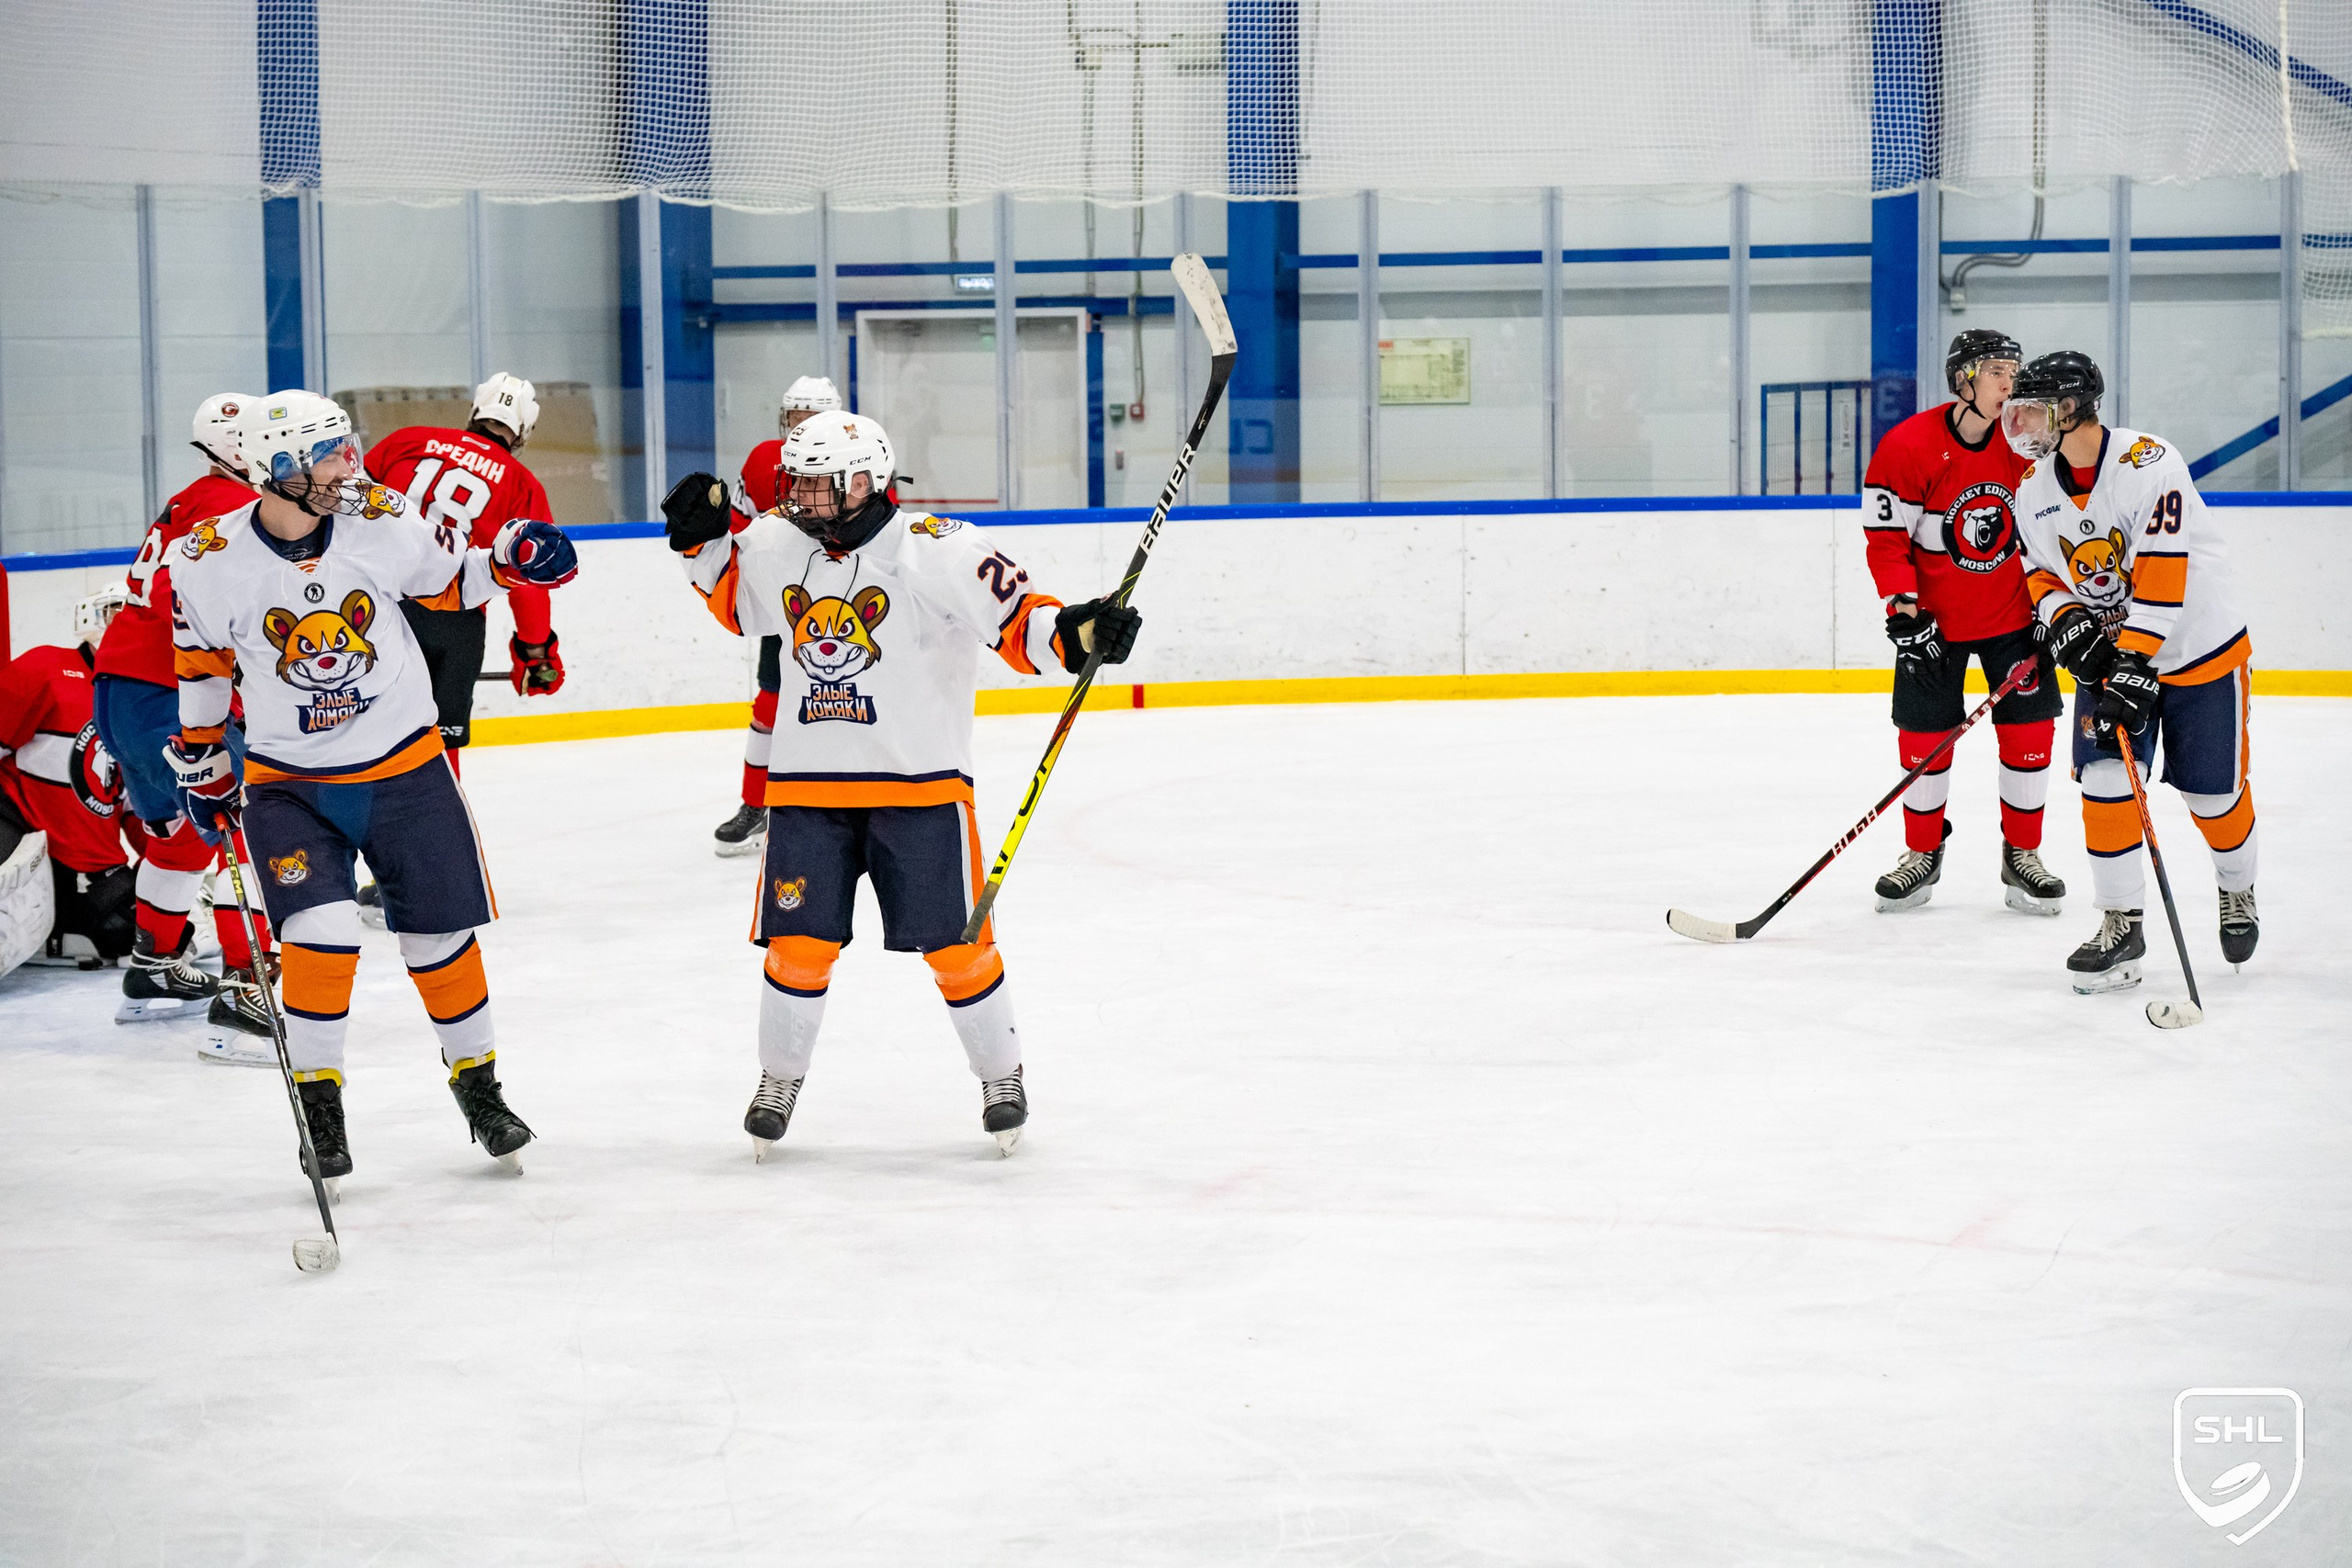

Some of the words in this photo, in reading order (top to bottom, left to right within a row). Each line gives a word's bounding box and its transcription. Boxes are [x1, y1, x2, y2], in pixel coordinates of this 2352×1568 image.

[2059, 381, 2080, 389] CCM
[498, 391, 514, 406] 18
[850, 456, 872, 466] CCM
[404, 457, 492, 537] 18
[1139, 442, 1196, 557] BAUER
[1877, 493, 1893, 522] 3
[1944, 486, 1982, 524] HOCKEY
[1984, 485, 2017, 515] EDITIO
[1958, 551, 2006, 571] MOSCOW
[2051, 619, 2094, 659] AUER
[812, 683, 854, 701] ЗЛЫЕ
[2111, 671, 2160, 695] BAUE
[315, 689, 358, 709] ЗЛЫЕ
[806, 697, 868, 722] ХОМЯКИ
[75, 724, 97, 752] HOC
[177, 766, 214, 783] UER
[226, 852, 243, 895] CCM
